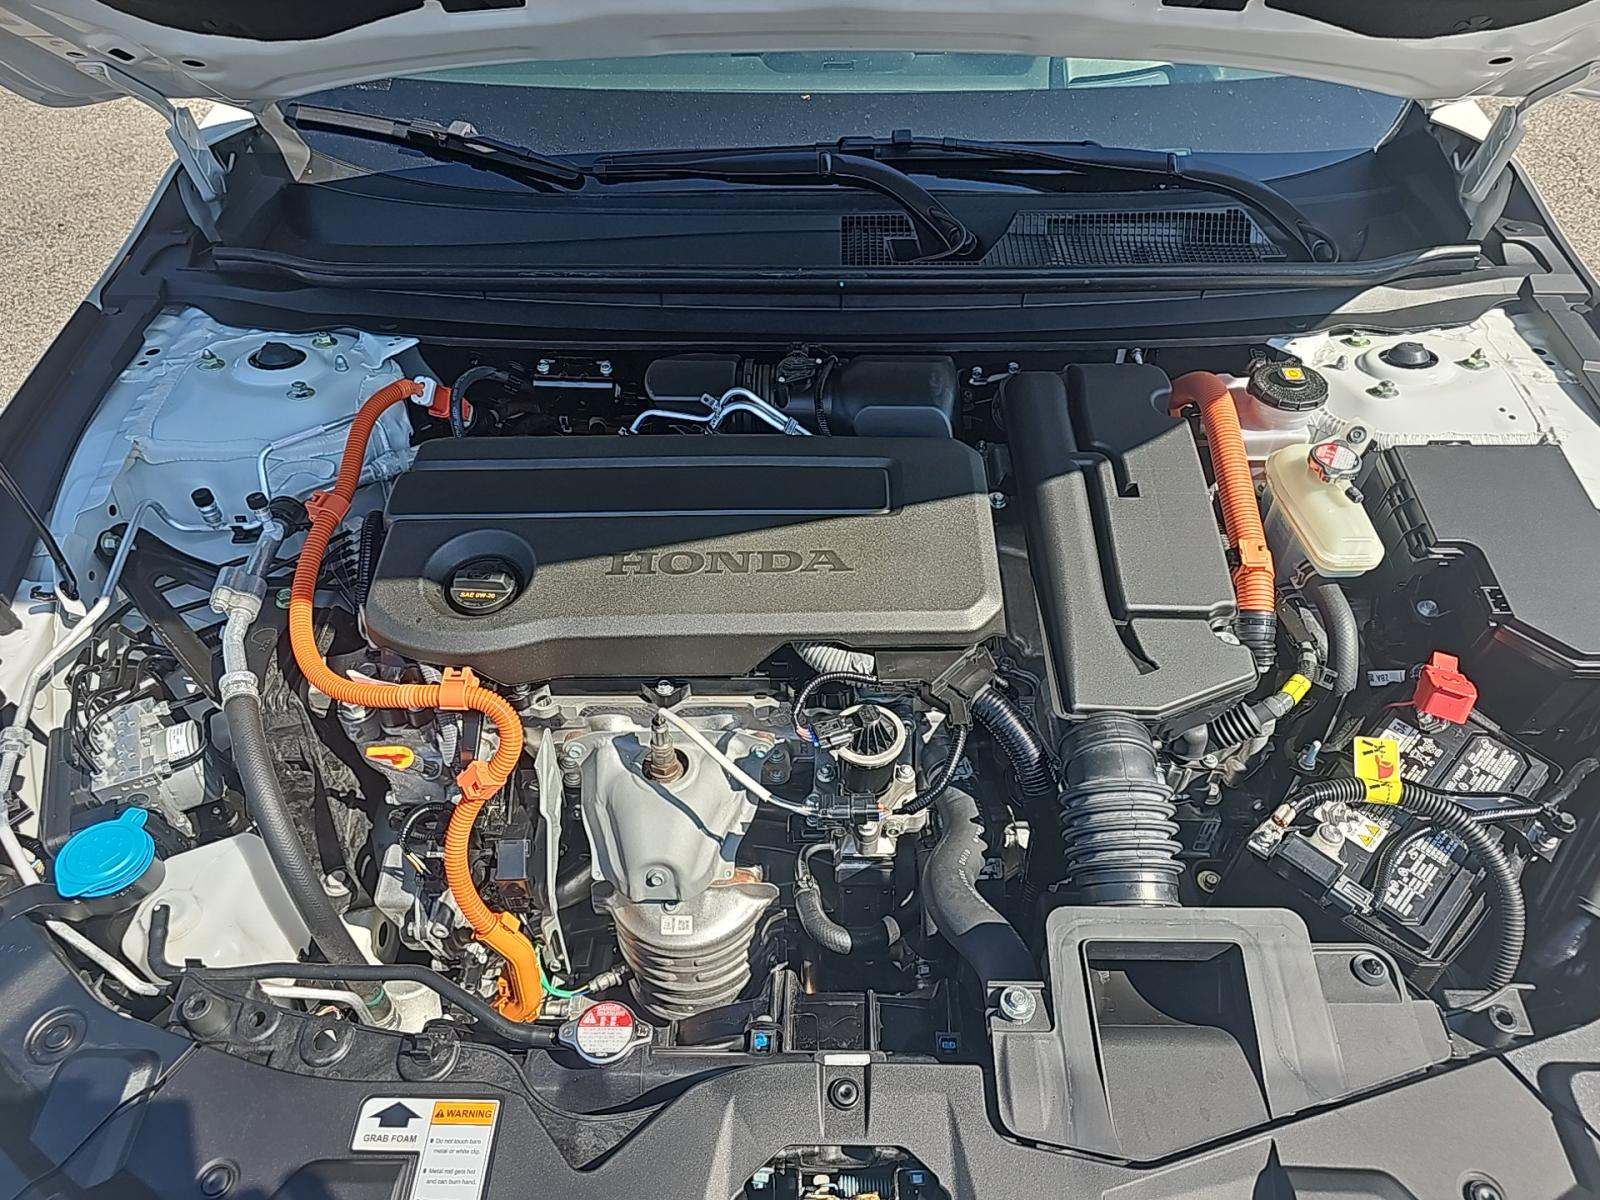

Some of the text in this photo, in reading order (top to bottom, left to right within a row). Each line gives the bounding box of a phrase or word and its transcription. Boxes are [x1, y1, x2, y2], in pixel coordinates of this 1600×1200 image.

[605, 549, 854, 576] HONDA
[446, 1109, 492, 1118] WARNING
[363, 1134, 418, 1143] GRAB FOAM
